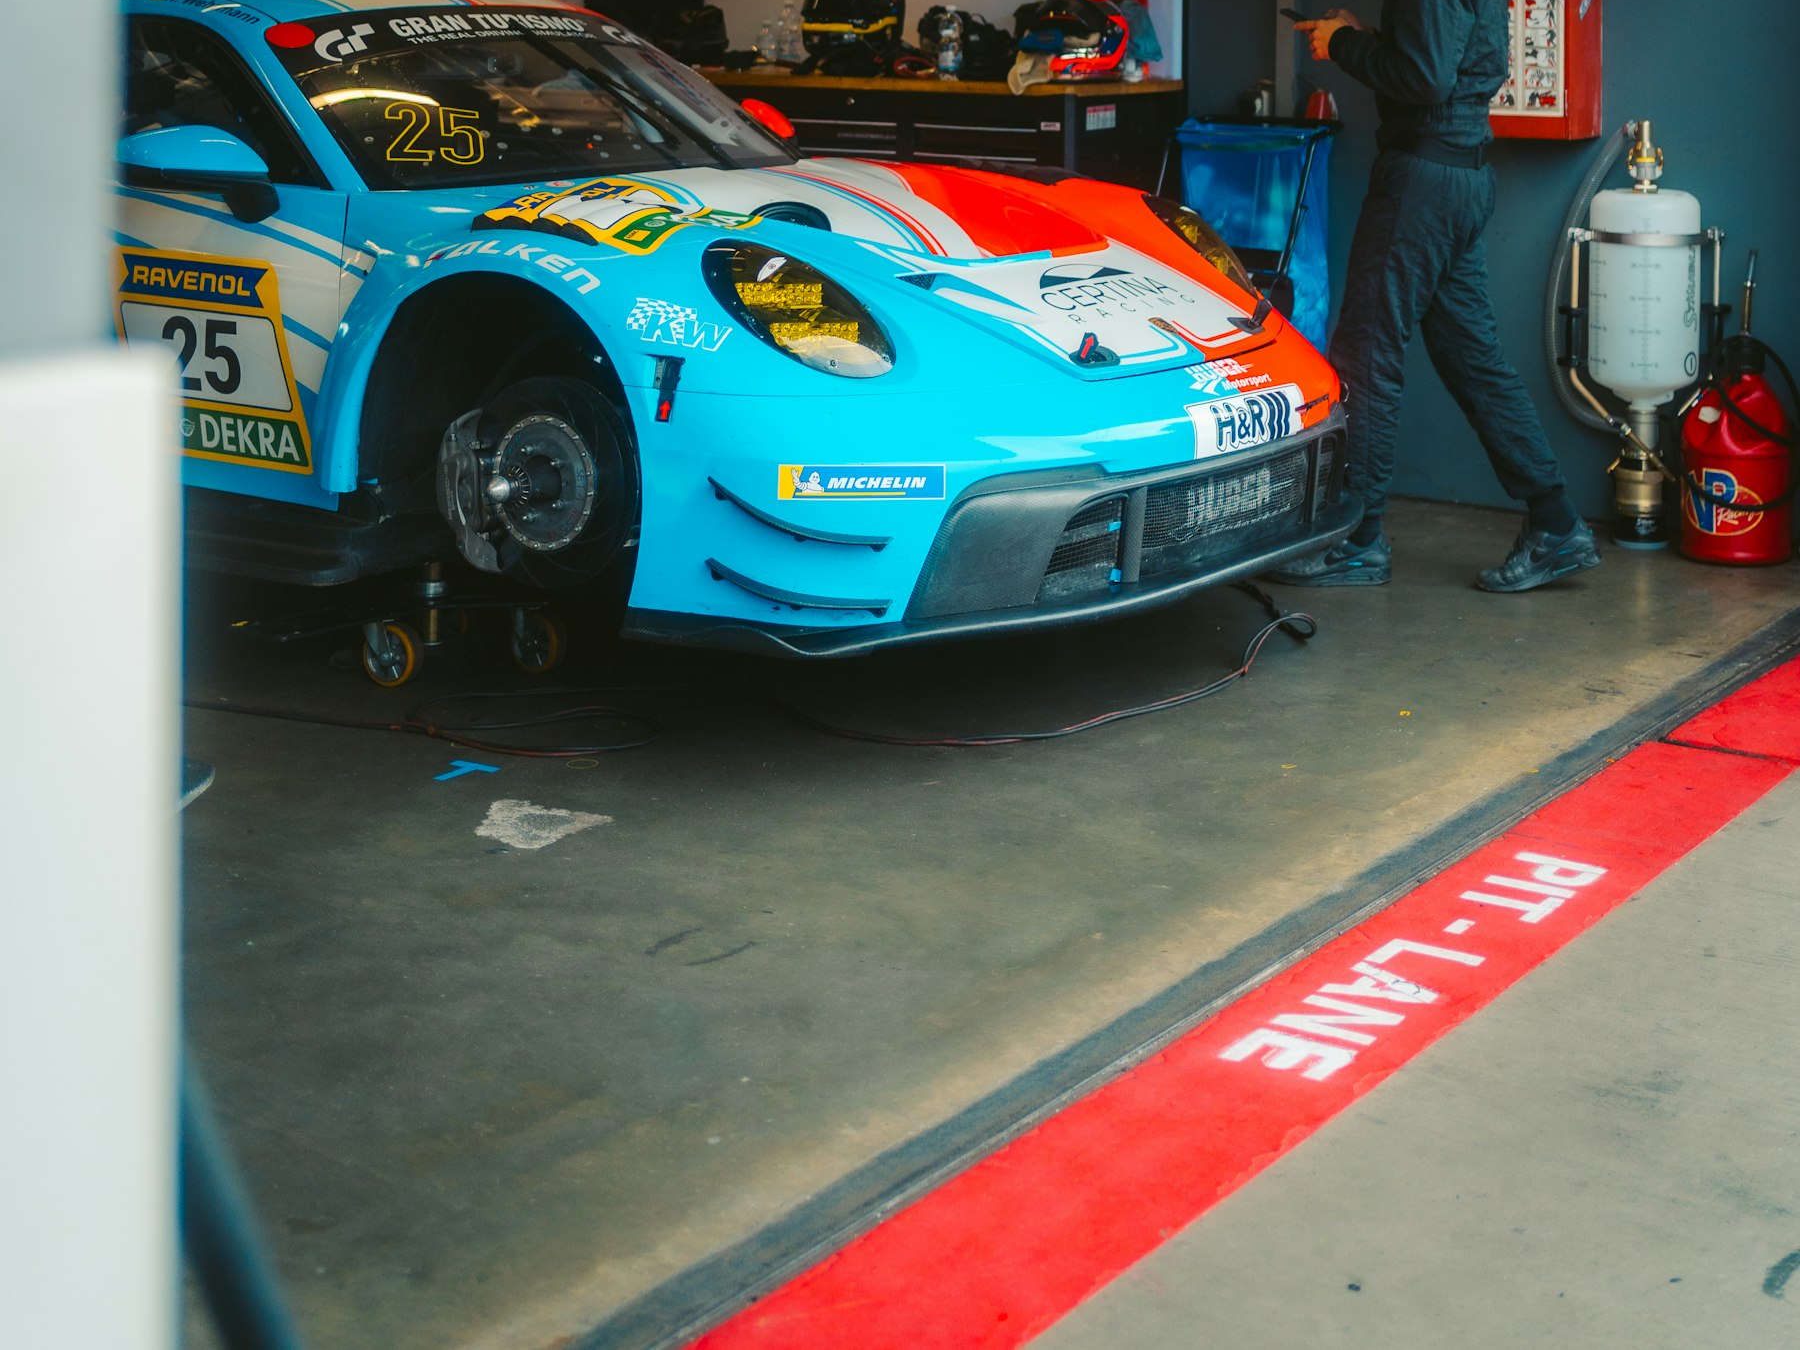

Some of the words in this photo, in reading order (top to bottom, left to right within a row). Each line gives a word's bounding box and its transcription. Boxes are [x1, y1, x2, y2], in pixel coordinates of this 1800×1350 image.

[388, 13, 467, 37] GRAN
[406, 34, 439, 45] THE
[438, 31, 476, 41] REAL
[384, 102, 485, 165] 25
[132, 265, 251, 297] RAVENOL
[422, 239, 602, 295] FALKEN
[1040, 276, 1178, 311] CERTINA
[1067, 293, 1196, 325] RACING
[640, 311, 733, 352] KW
[161, 315, 241, 395] 25
[1184, 358, 1249, 384] HUBER
[1221, 373, 1272, 391] Motorsport
[199, 413, 301, 461] DEKRA
[1211, 397, 1267, 450] H&R
[827, 476, 927, 489] MICHELIN
[1459, 851, 1609, 924] PIT
[1217, 938, 1486, 1081] LANE
